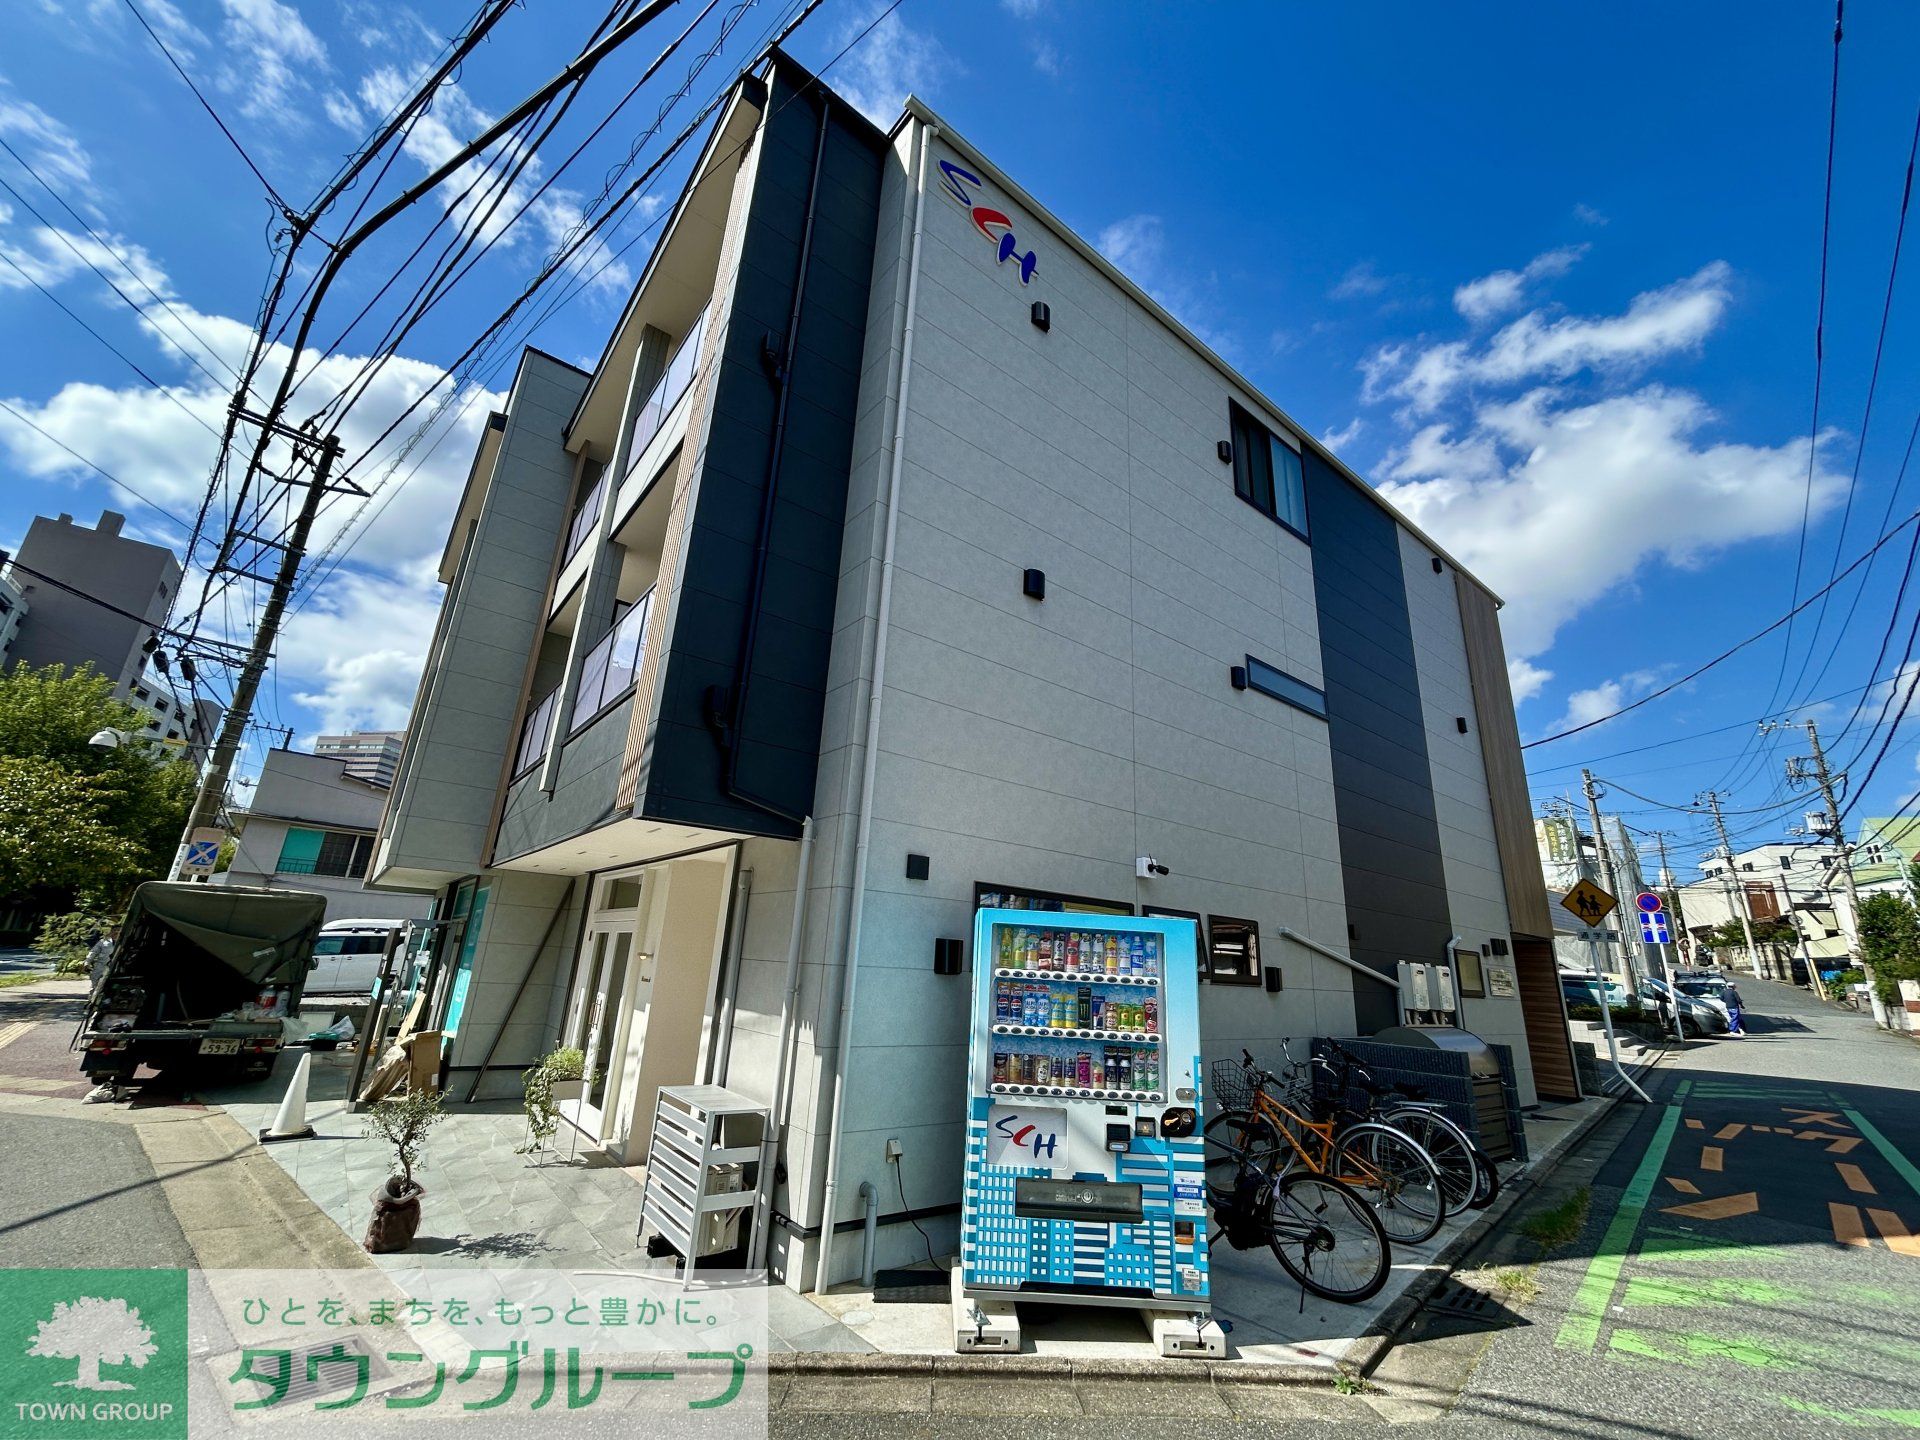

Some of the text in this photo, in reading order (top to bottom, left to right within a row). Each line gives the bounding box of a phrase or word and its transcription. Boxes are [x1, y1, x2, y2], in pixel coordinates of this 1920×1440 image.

[937, 159, 1039, 287] SCH
[1580, 931, 1616, 940] 通学路
[995, 1114, 1058, 1159] SCH
